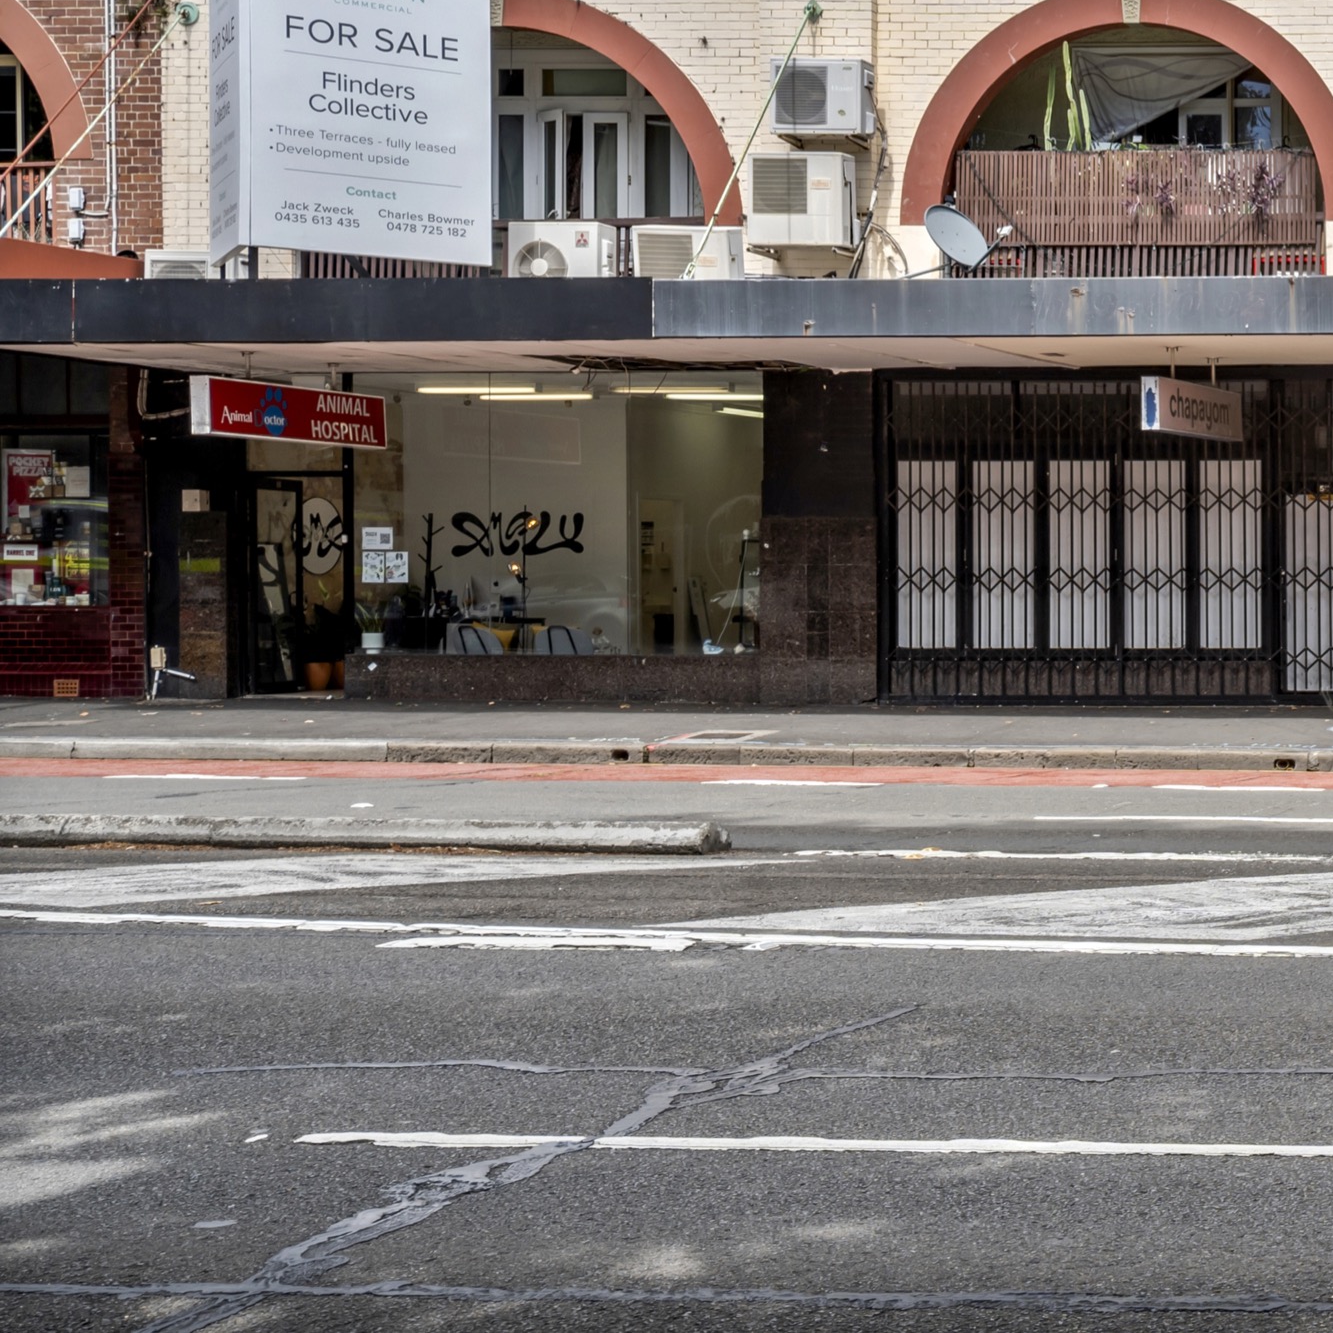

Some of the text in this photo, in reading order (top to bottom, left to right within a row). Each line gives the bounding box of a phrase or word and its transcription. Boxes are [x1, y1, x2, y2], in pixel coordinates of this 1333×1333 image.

[285, 14, 459, 61] FOR SALE
[322, 71, 415, 100] Flinders
[308, 94, 429, 125] Collective
[276, 125, 315, 139] Three
[319, 129, 374, 146] Terraces
[386, 136, 412, 152] fully
[415, 140, 457, 155] leased
[276, 142, 410, 167] Development upside
[346, 186, 397, 200] Contact
[280, 200, 354, 215] Jack Zweck
[378, 209, 475, 227] Charles Bowmer
[274, 212, 360, 229] 0435 613 435
[386, 221, 467, 238] 0478 725 182
[221, 405, 253, 424] Animal
[316, 394, 370, 417] ANIMAL
[1169, 387, 1230, 430] chapayom
[311, 419, 378, 443] HOSPITAL
[9, 456, 50, 466] POCKET
